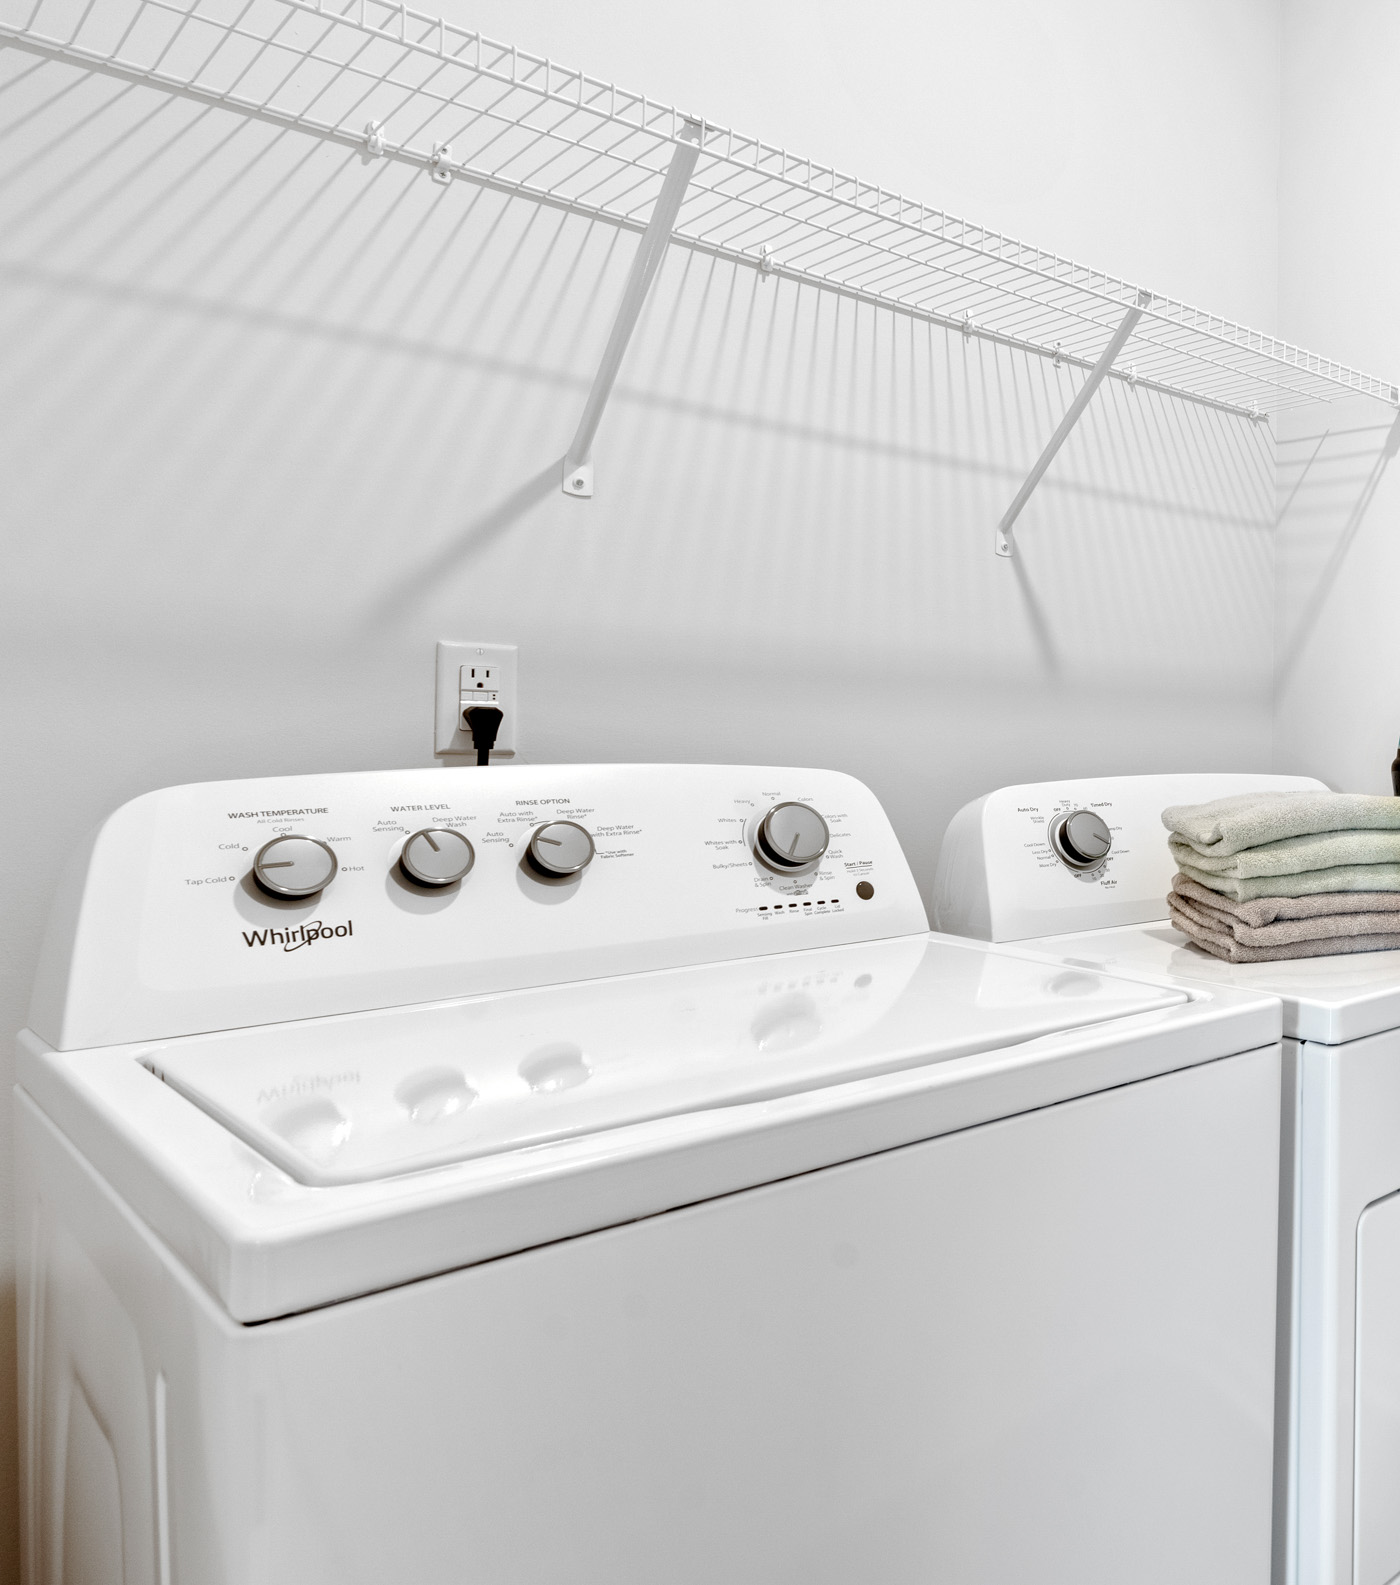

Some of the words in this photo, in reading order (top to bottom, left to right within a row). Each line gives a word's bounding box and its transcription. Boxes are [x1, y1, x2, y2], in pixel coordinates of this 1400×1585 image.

[228, 811, 259, 819] WASH
[260, 808, 329, 817] TEMPERATURE
[712, 862, 748, 870] Bulky/Sheets
[205, 876, 227, 884] Cold
[241, 920, 353, 951] Whirlpool
